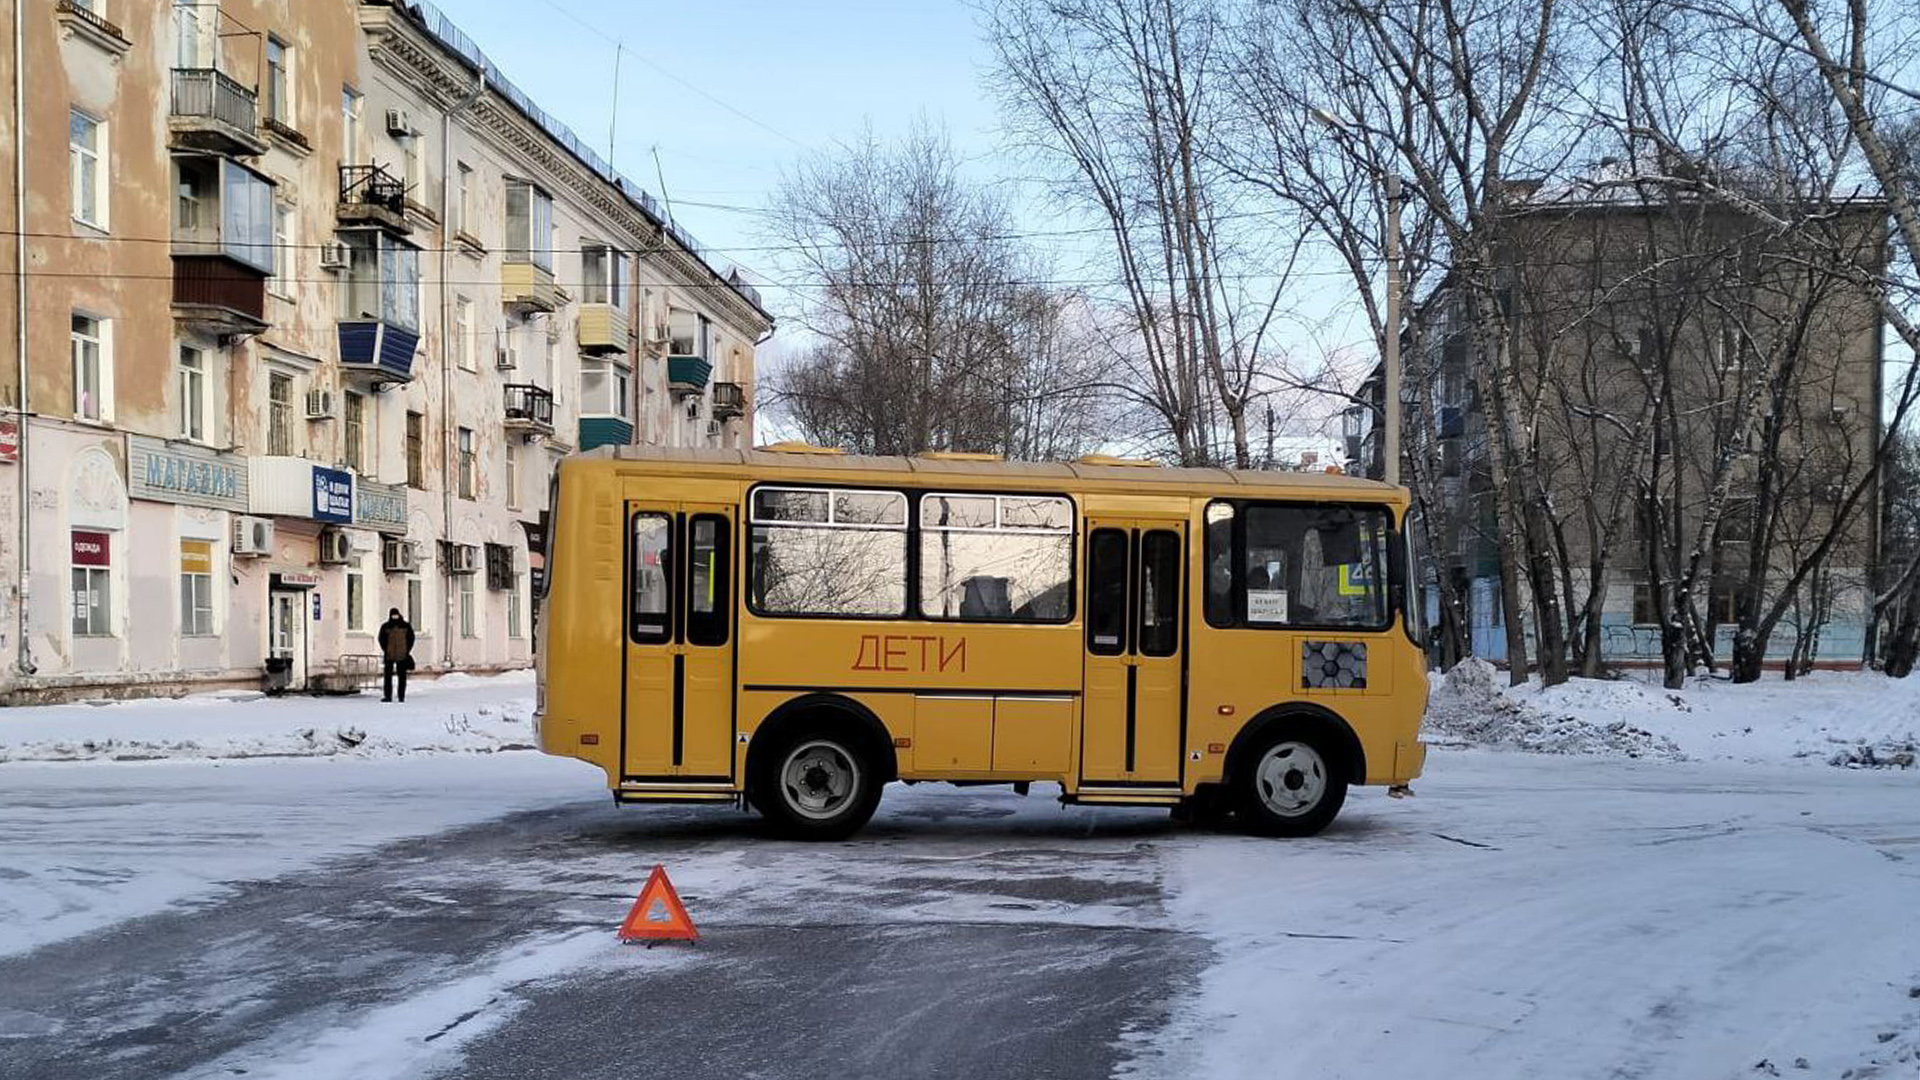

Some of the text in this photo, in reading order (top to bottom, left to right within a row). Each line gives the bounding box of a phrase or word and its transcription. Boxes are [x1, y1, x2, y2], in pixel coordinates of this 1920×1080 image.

[145, 453, 235, 498] МАГАЗИН
[74, 541, 101, 554] ОДЕЖДА
[851, 634, 966, 673] ДЕТИ
